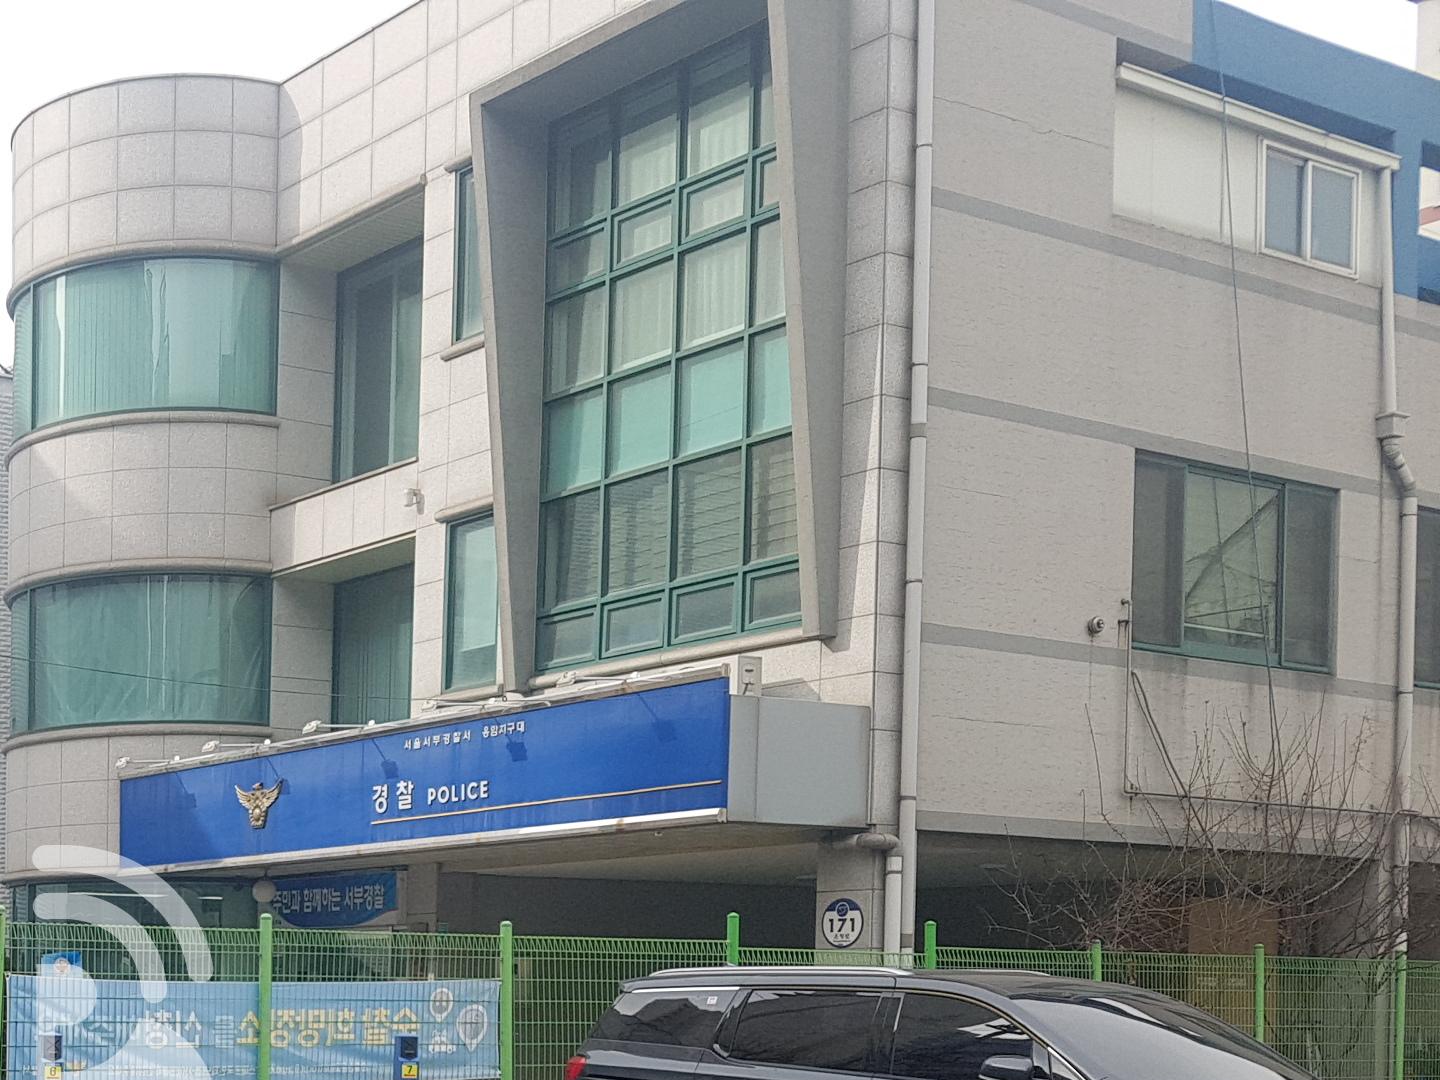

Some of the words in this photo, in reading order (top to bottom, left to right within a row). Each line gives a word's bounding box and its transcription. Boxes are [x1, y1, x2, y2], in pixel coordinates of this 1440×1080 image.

[372, 780, 415, 814] 경찰
[427, 780, 489, 805] POLICE
[303, 887, 342, 913] 함께하는
[344, 884, 385, 911] 서부경찰
[828, 917, 856, 933] 171
[406, 1065, 413, 1074] 7
